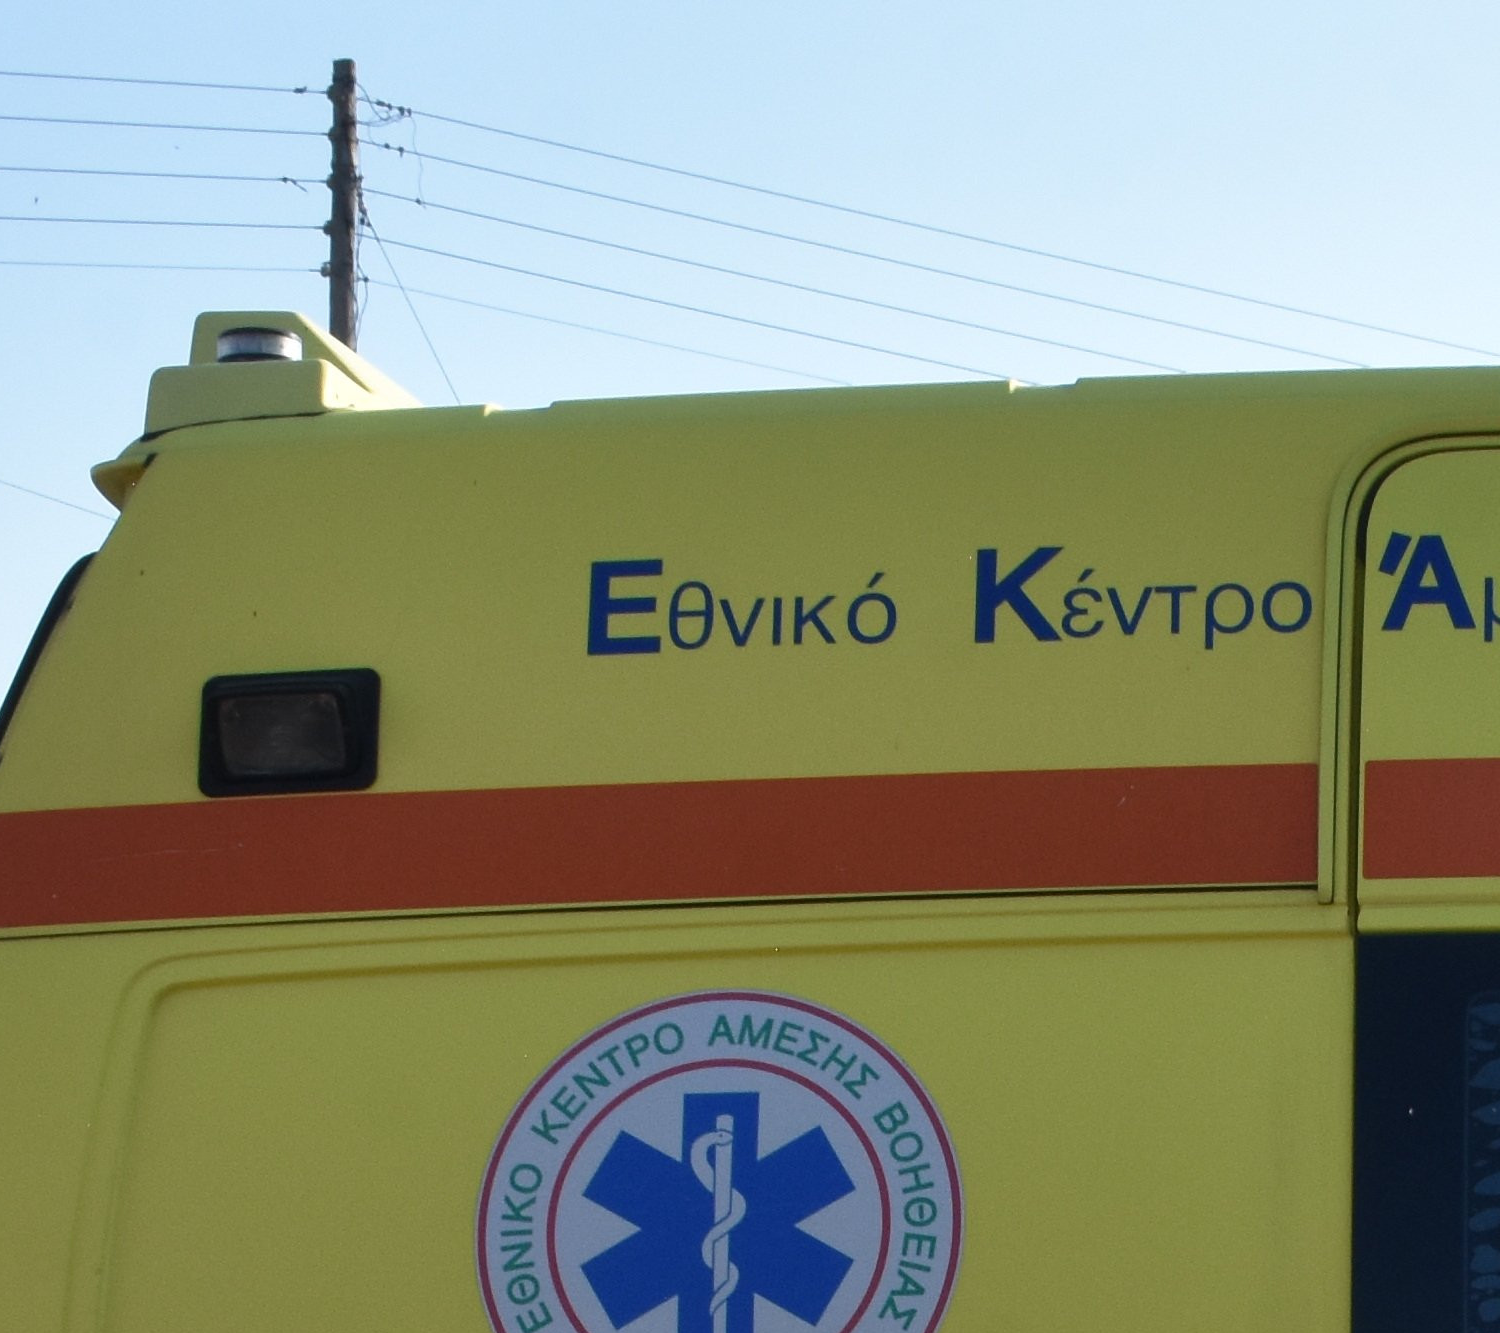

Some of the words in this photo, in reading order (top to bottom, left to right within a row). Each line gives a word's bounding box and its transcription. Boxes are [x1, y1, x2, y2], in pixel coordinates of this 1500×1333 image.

[586, 558, 898, 656] Εθνικό
[974, 545, 1313, 648] Κέντρο
[530, 1022, 684, 1145] ΚΕΝΤΡΟ
[708, 1014, 880, 1099] ΑΜΕΣΗΣ
[872, 1101, 938, 1331] ΒΟΗΘΕΙΑΣ
